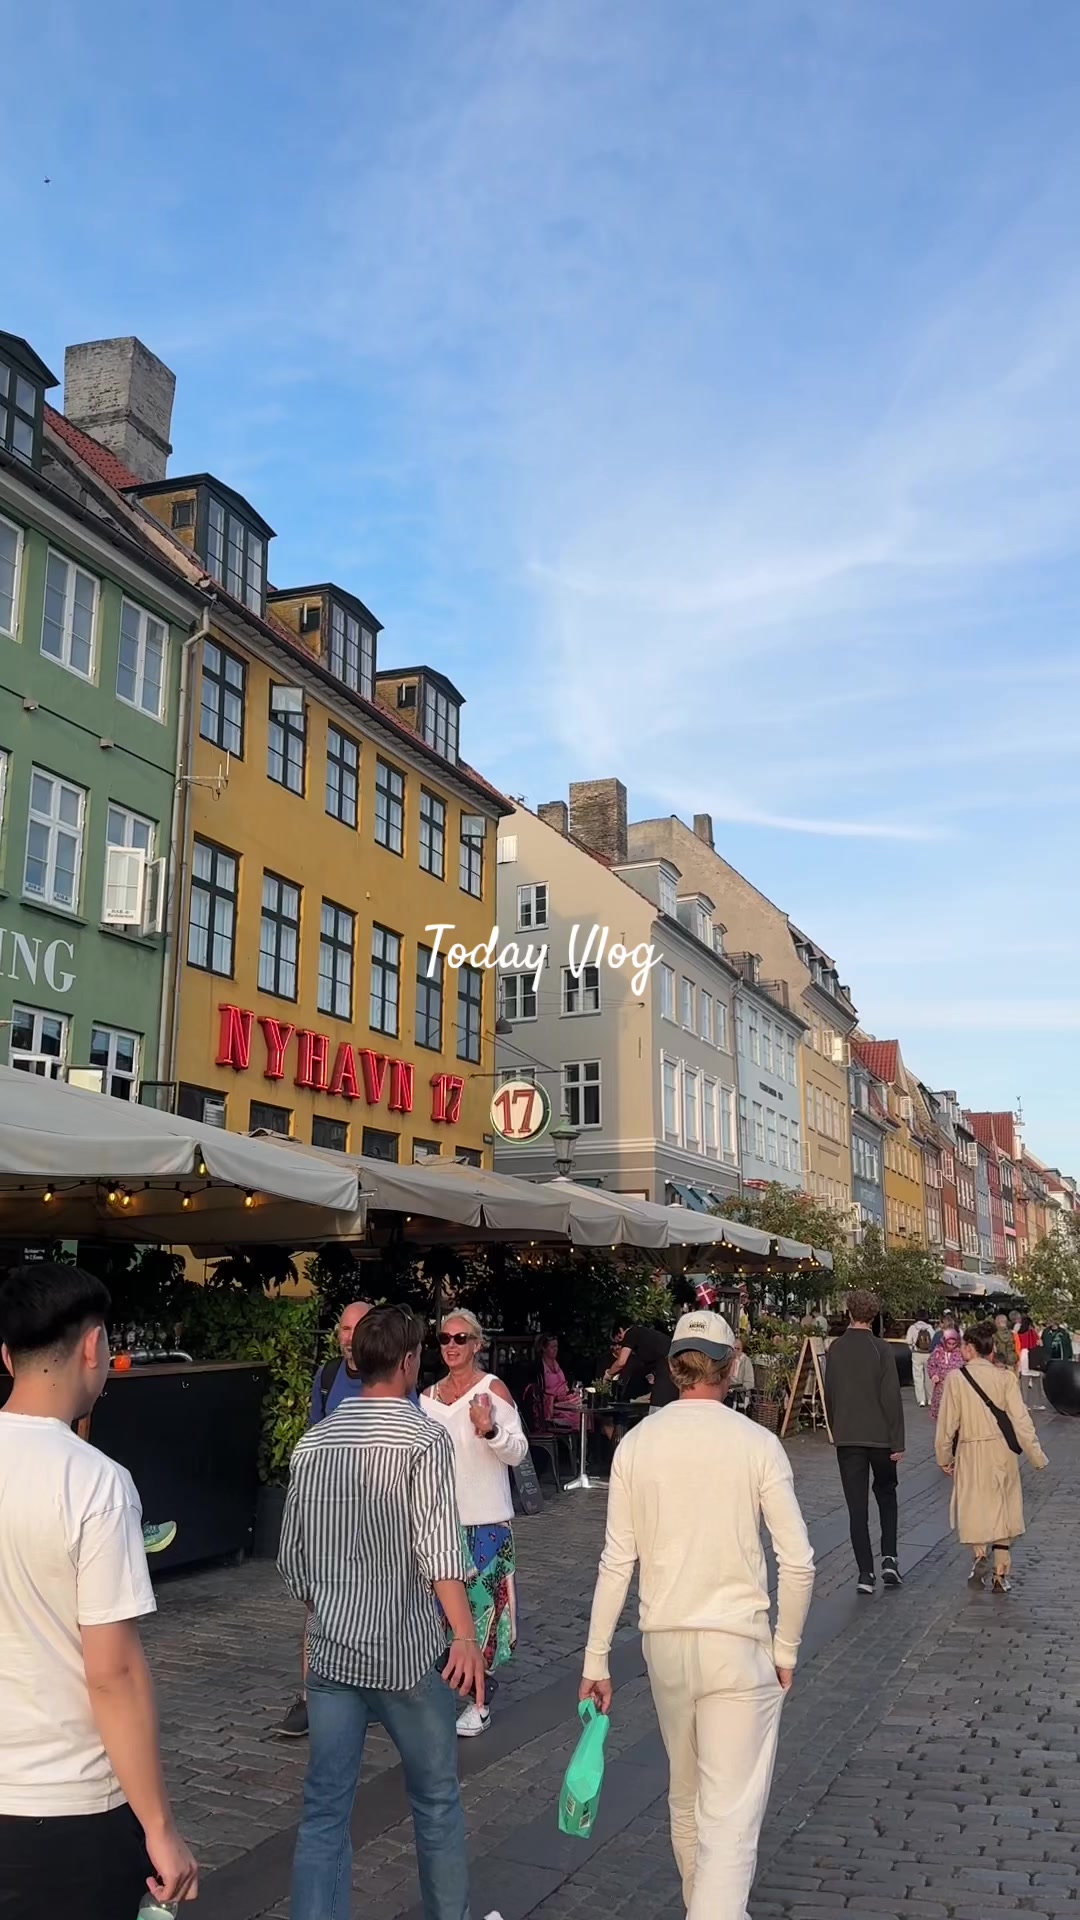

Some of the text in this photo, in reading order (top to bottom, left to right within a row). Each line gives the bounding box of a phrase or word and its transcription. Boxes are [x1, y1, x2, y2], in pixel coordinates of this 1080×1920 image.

[215, 1003, 465, 1125] NYHAVN 17
[493, 1088, 537, 1135] 17
